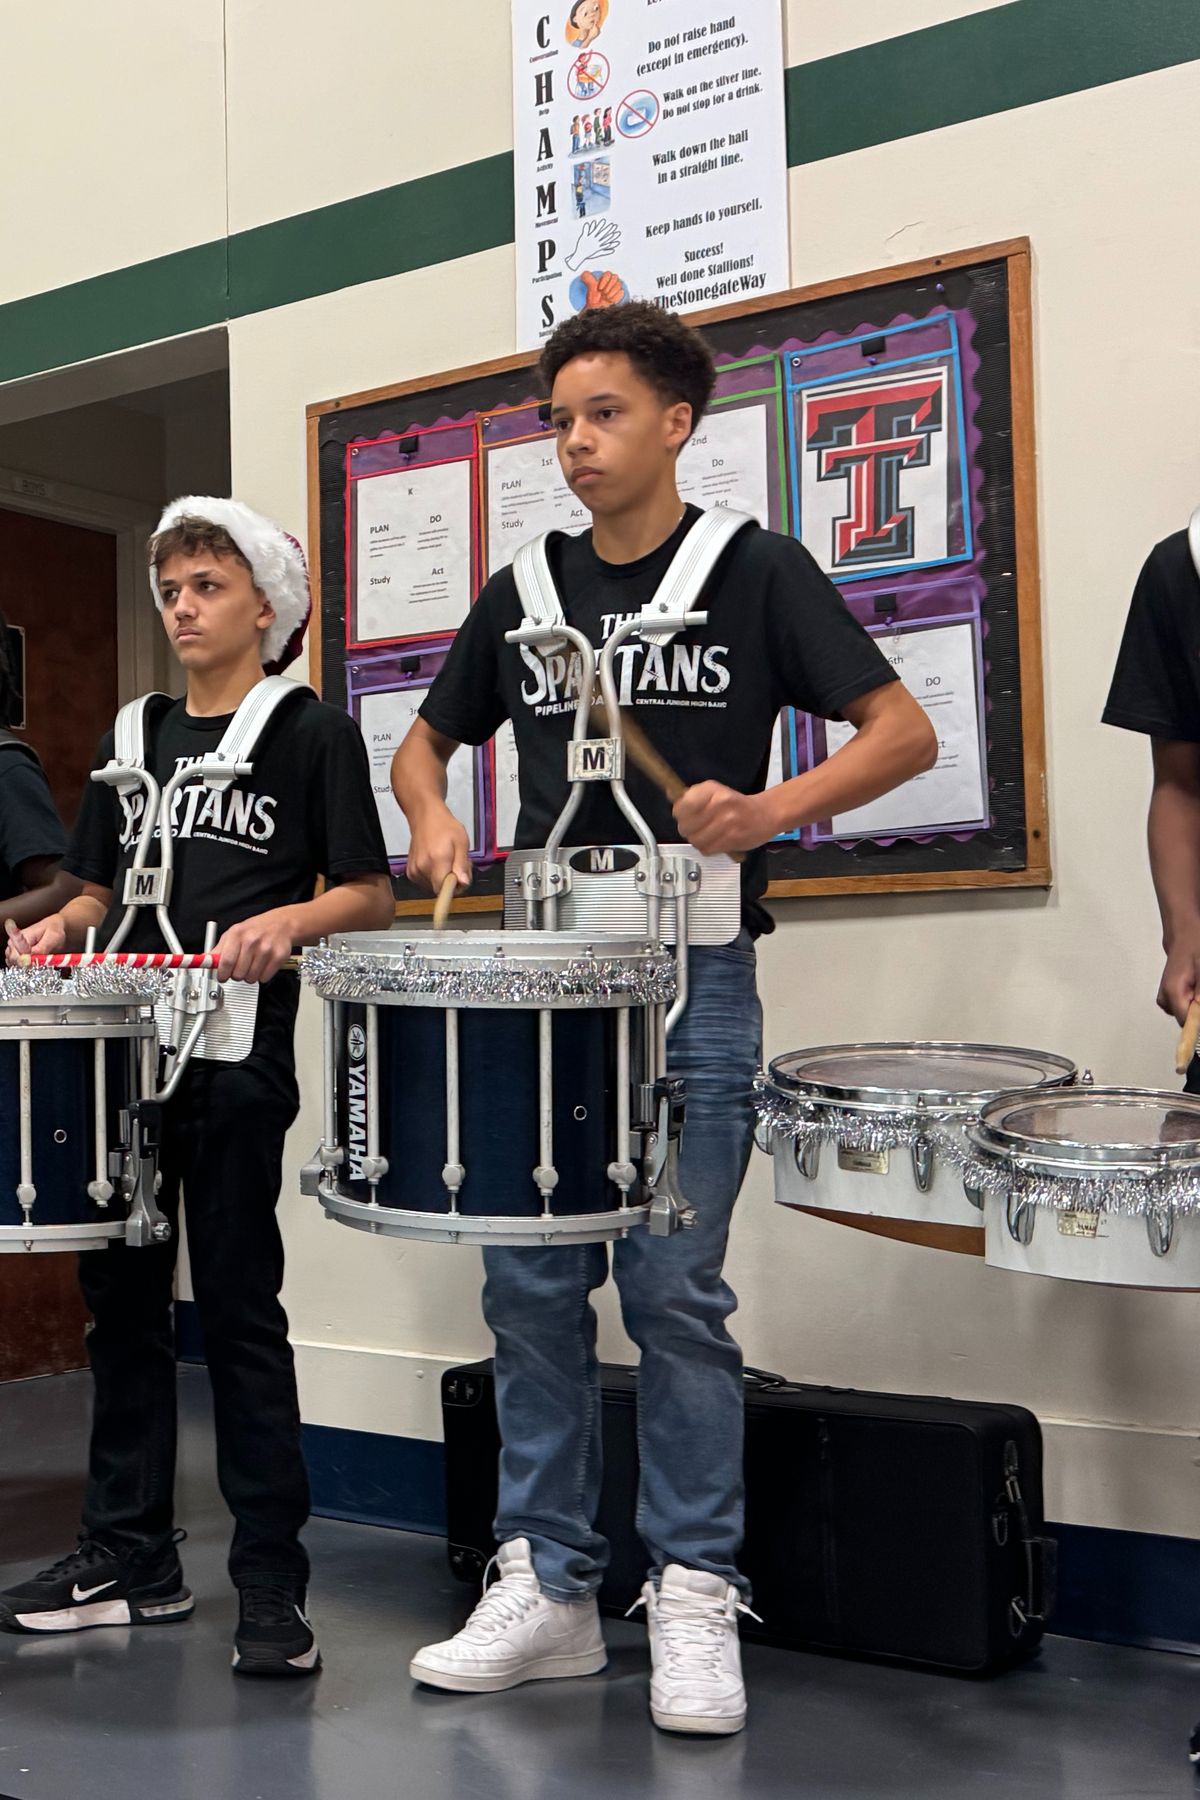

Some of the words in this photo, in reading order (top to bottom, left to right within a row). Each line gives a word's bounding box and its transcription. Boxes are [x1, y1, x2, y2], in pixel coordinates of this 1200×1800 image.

[648, 41, 661, 53] Do
[664, 33, 680, 49] not
[683, 26, 707, 43] raise
[710, 16, 735, 35] hand
[636, 55, 671, 77] (except
[674, 52, 684, 64] in
[687, 33, 748, 60] emergency).
[663, 89, 684, 102] Walk
[686, 85, 698, 96] on
[700, 81, 714, 93] the
[715, 73, 739, 88] silver
[742, 67, 762, 80] line.
[662, 109, 674, 120] Do
[676, 103, 690, 116] not
[692, 98, 711, 111] stop
[713, 93, 725, 105] for
[728, 91, 734, 100] a
[736, 83, 763, 98] drink.
[652, 151, 677, 166] Walk
[679, 142, 707, 159] down
[710, 136, 726, 151] the
[728, 129, 748, 146] hall
[658, 172, 668, 184] in
[670, 170, 677, 181] a
[679, 158, 718, 178] straight
[721, 153, 744, 167] line.
[645, 224, 670, 238] Keep
[673, 213, 703, 231] hands
[705, 211, 716, 222] to
[718, 198, 762, 221] yourself.
[684, 243, 724, 263] Success!
[656, 274, 677, 289] Well
[680, 268, 705, 283] done
[707, 255, 754, 276] Stallions!
[691, 435, 707, 446] 2nd
[541, 458, 553, 467] 1st
[712, 458, 724, 468] Do
[408, 488, 413, 496] K
[501, 480, 522, 491] PLAN
[430, 515, 442, 524] DO
[570, 509, 583, 518] Act
[370, 524, 389, 534] PLAN
[501, 520, 524, 530] Study
[370, 576, 391, 586] Study
[431, 567, 444, 576] Act
[600, 612, 642, 640] TH
[888, 656, 904, 665] 6th
[520, 643, 731, 706] SPATANS
[925, 676, 941, 687] DO
[373, 733, 392, 742] PLAN
[175, 757, 204, 777] TH
[582, 747, 605, 770] M
[590, 850, 615, 872] M
[136, 874, 154, 896] M
[348, 1064, 366, 1180] YAMAHA
